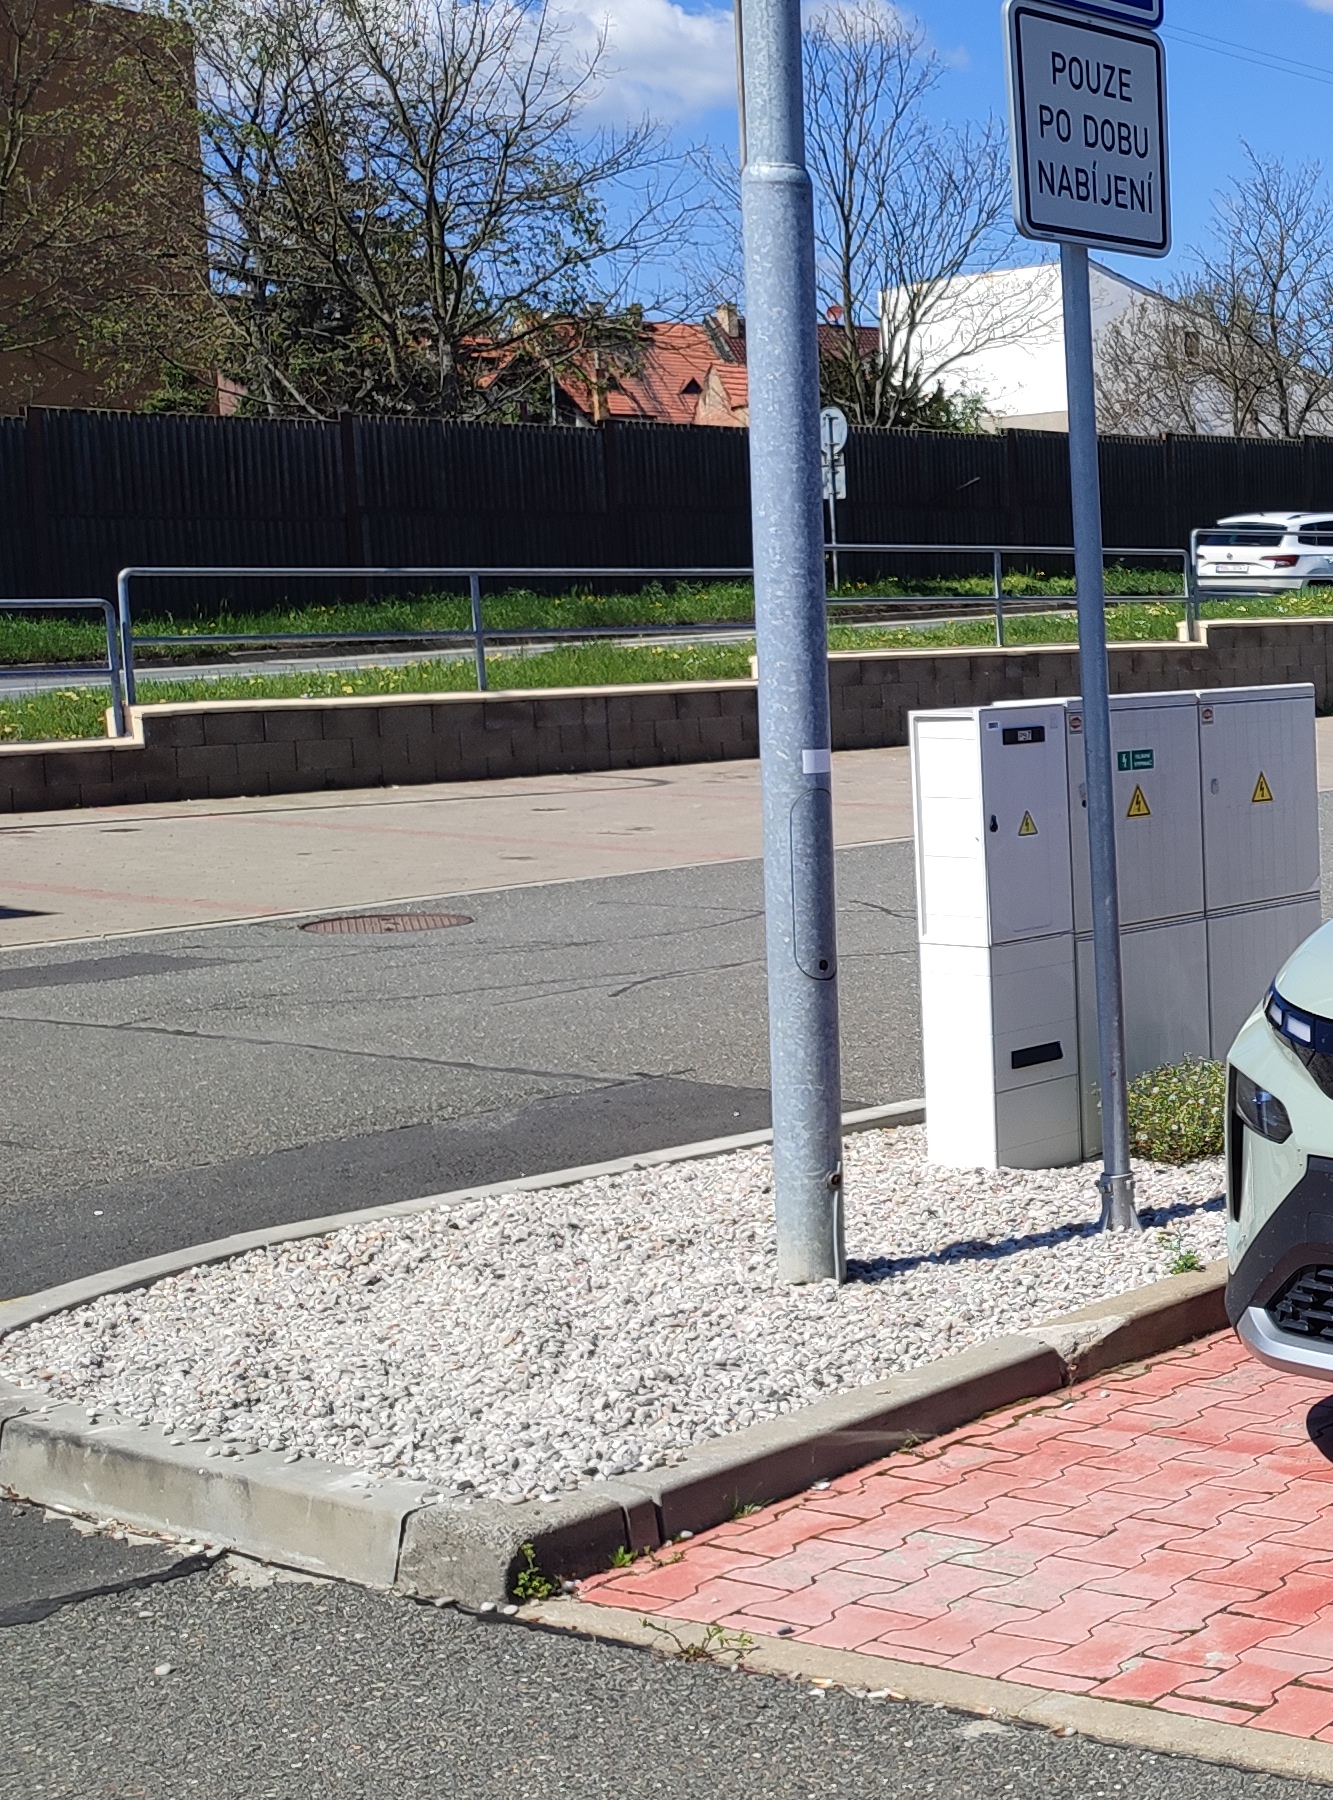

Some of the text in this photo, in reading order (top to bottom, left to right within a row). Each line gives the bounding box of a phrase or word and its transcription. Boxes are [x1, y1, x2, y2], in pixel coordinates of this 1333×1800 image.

[1052, 51, 1132, 102] POUZE
[1039, 104, 1148, 158] PO DOBU
[1038, 160, 1152, 213] NABÍJENÍ
